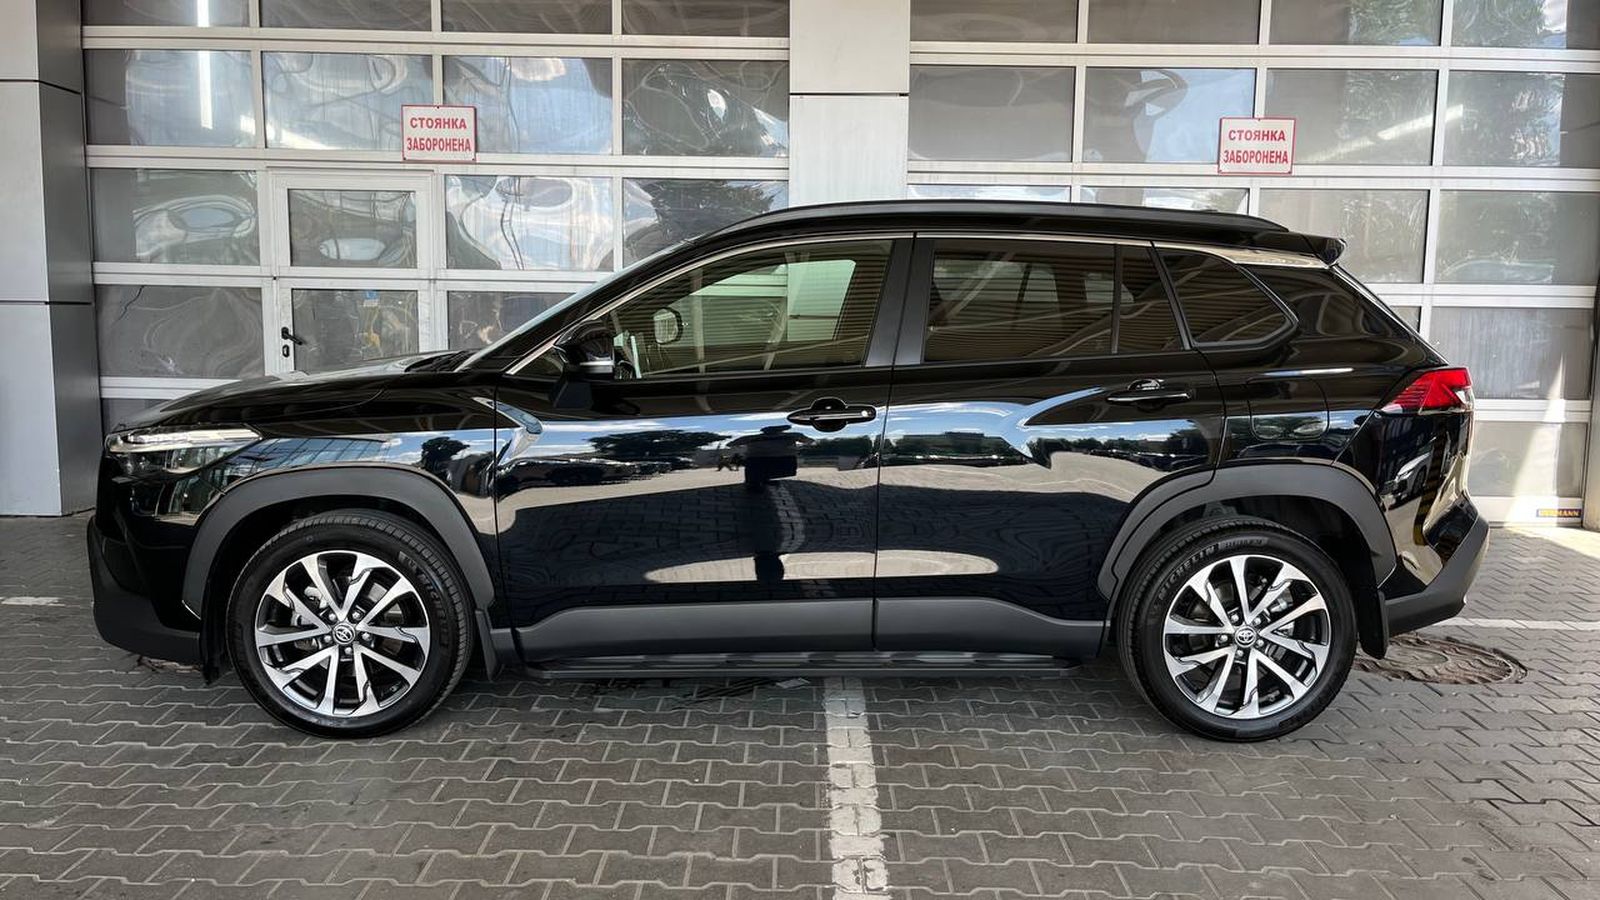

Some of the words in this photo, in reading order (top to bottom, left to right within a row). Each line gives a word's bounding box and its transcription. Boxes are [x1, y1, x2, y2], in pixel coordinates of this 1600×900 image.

[410, 117, 467, 129] СТОЯНКА
[1228, 129, 1286, 141] СТОЯНКА
[406, 137, 472, 152] ЗАБОРОНЕНА
[1223, 149, 1289, 164] ЗАБОРОНЕНА
[1158, 545, 1216, 601] MICHELIN
